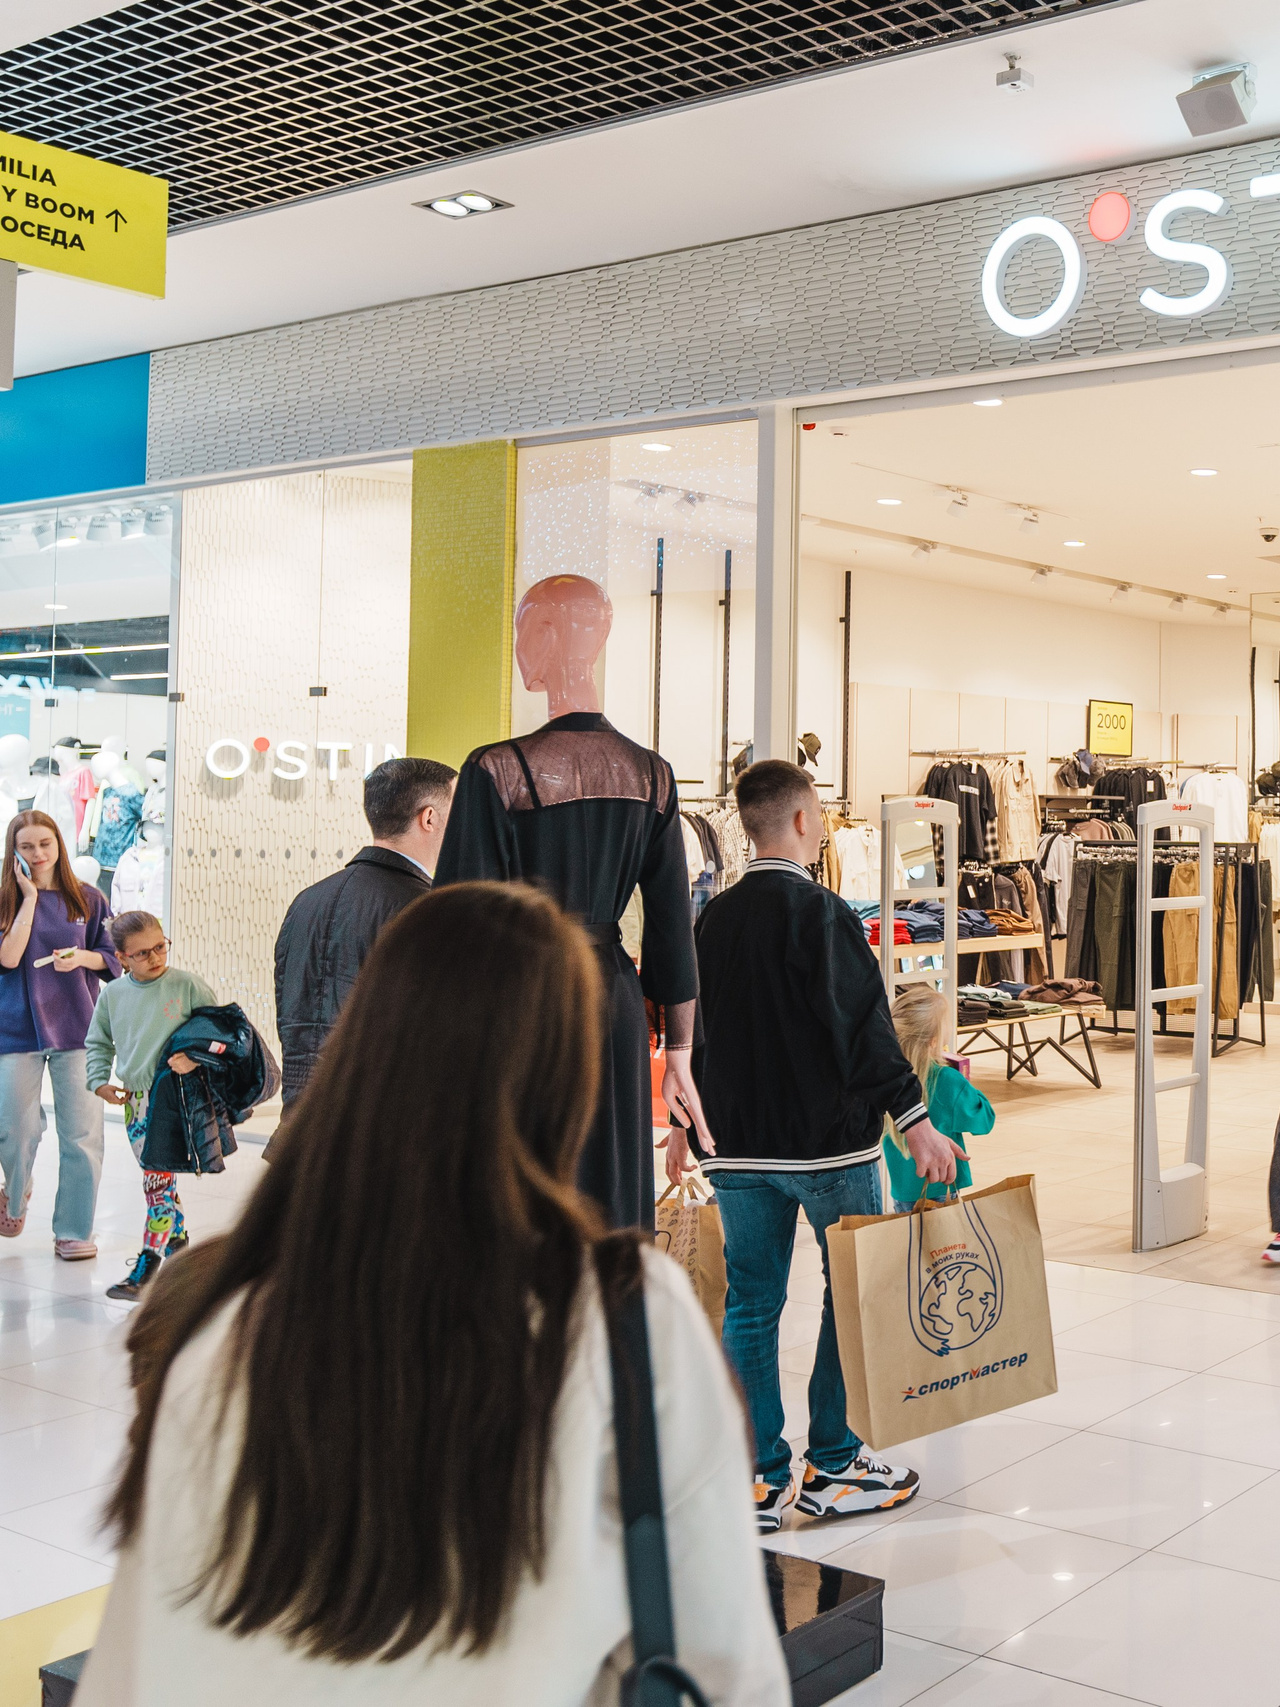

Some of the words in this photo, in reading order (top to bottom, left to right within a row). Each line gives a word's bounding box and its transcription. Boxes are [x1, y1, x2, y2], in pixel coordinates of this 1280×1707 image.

[25, 192, 95, 225] BOOM
[0, 216, 86, 252] ОСЕДА
[1097, 713, 1127, 730] 2000
[930, 1243, 967, 1259] Планета
[931, 1254, 954, 1269] моих
[955, 1251, 980, 1260] руках
